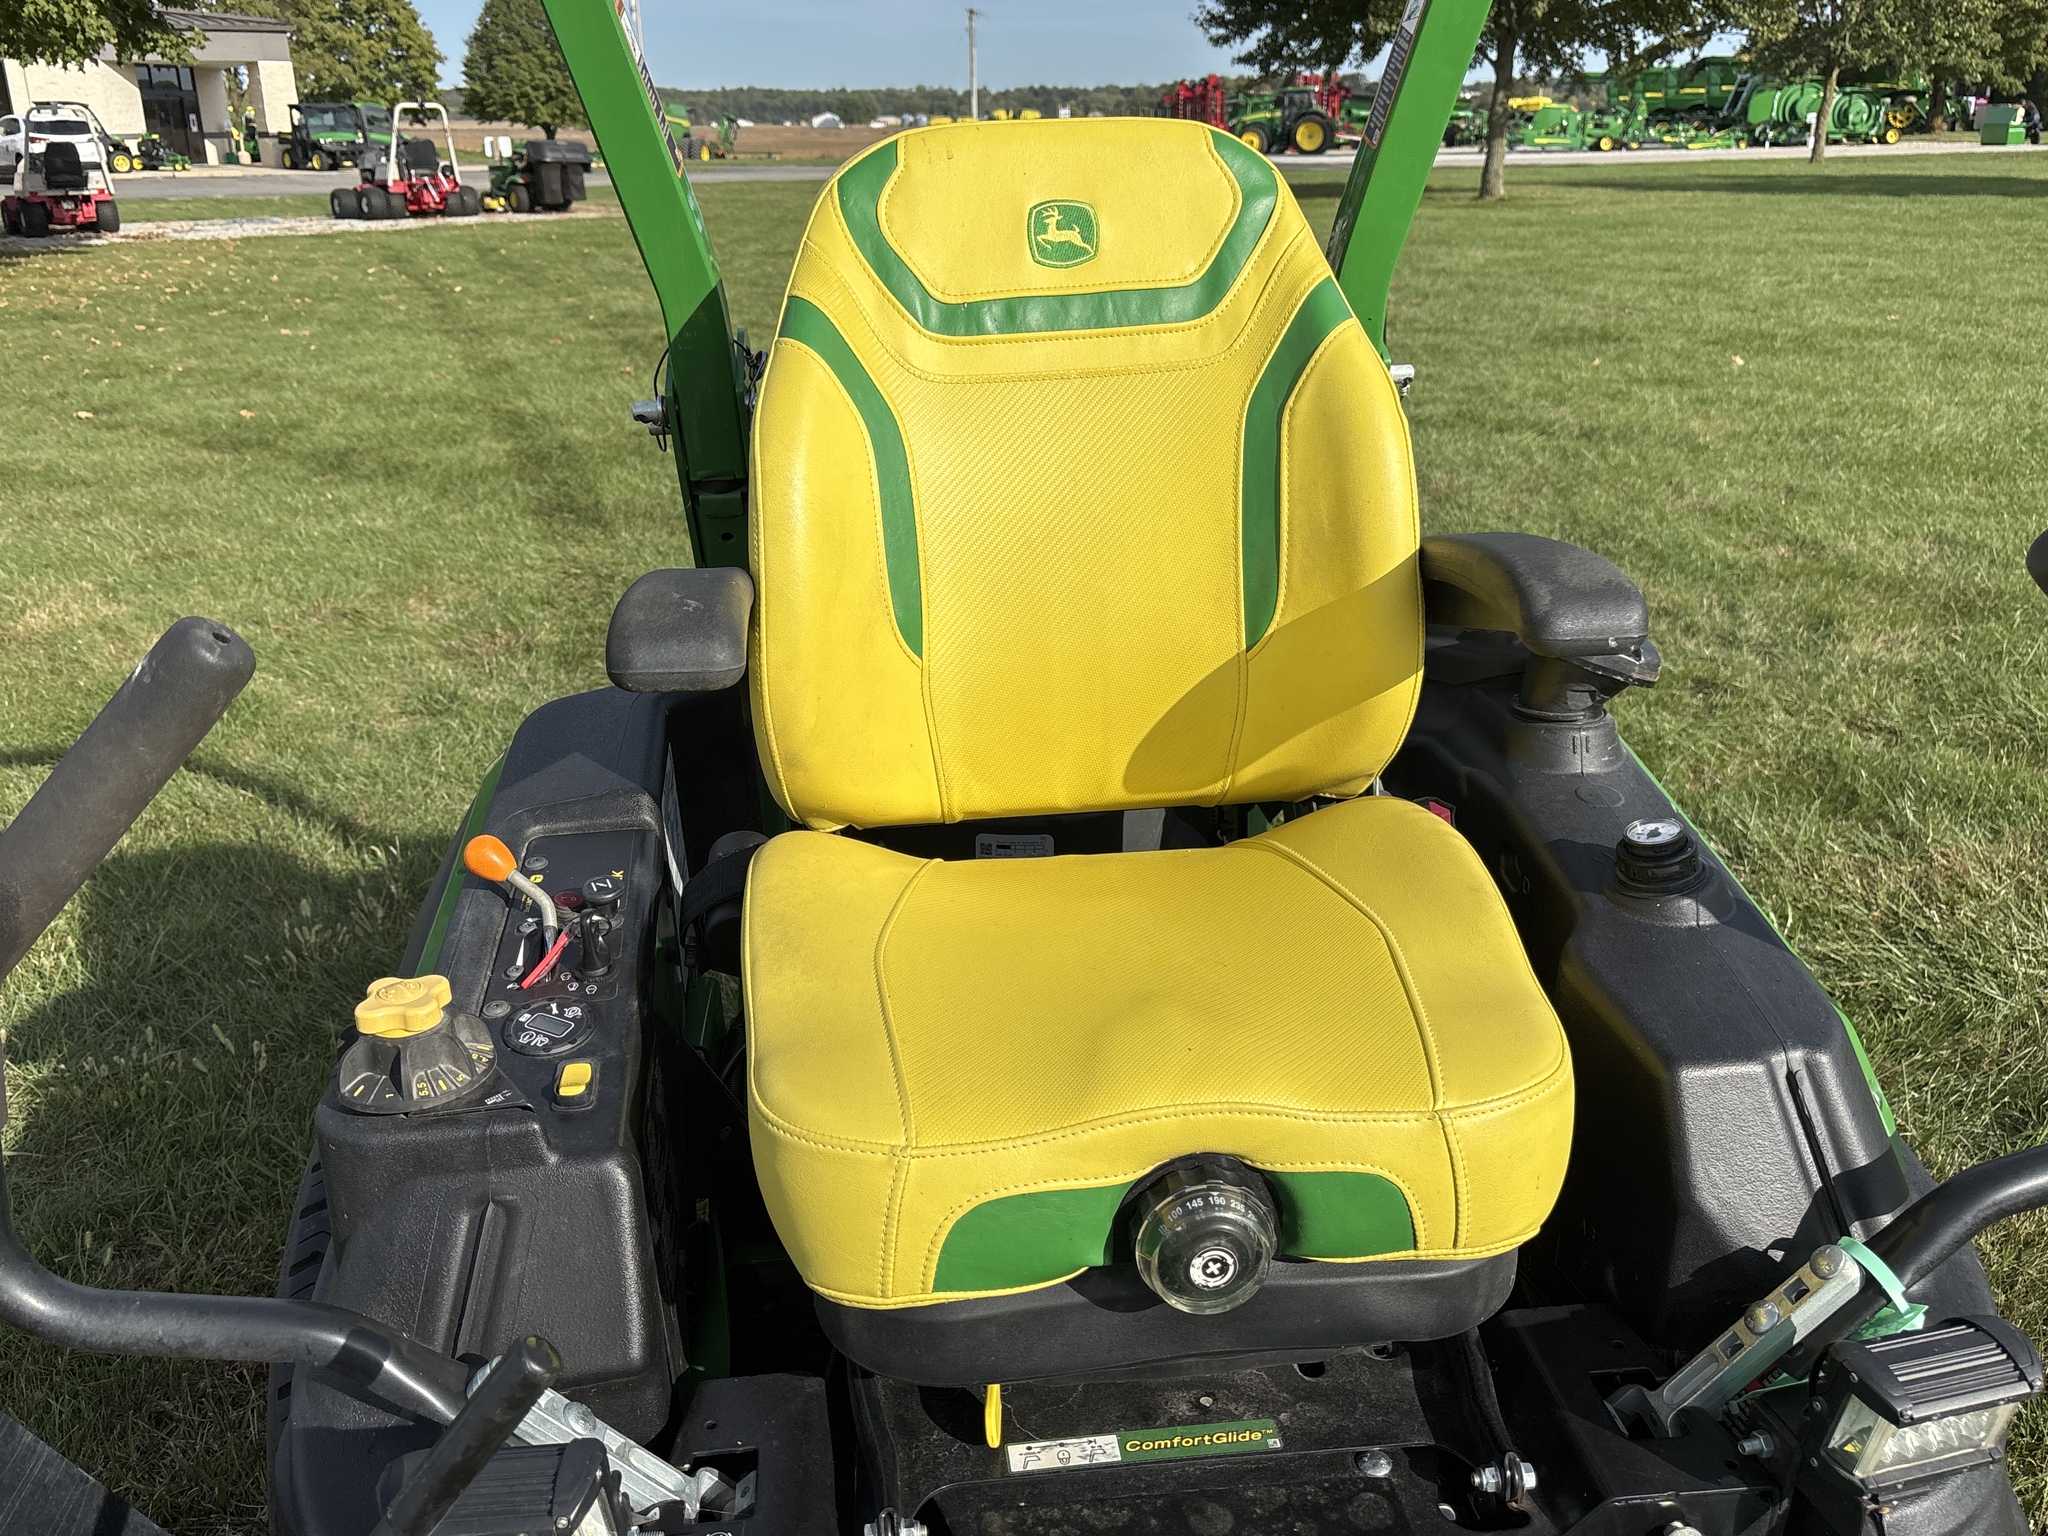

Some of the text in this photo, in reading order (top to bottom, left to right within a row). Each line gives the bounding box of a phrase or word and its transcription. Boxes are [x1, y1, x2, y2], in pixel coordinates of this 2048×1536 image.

[455, 1073, 466, 1082] 5
[416, 1082, 429, 1097] 5.5
[1167, 1196, 1245, 1222] 100 145 190 235
